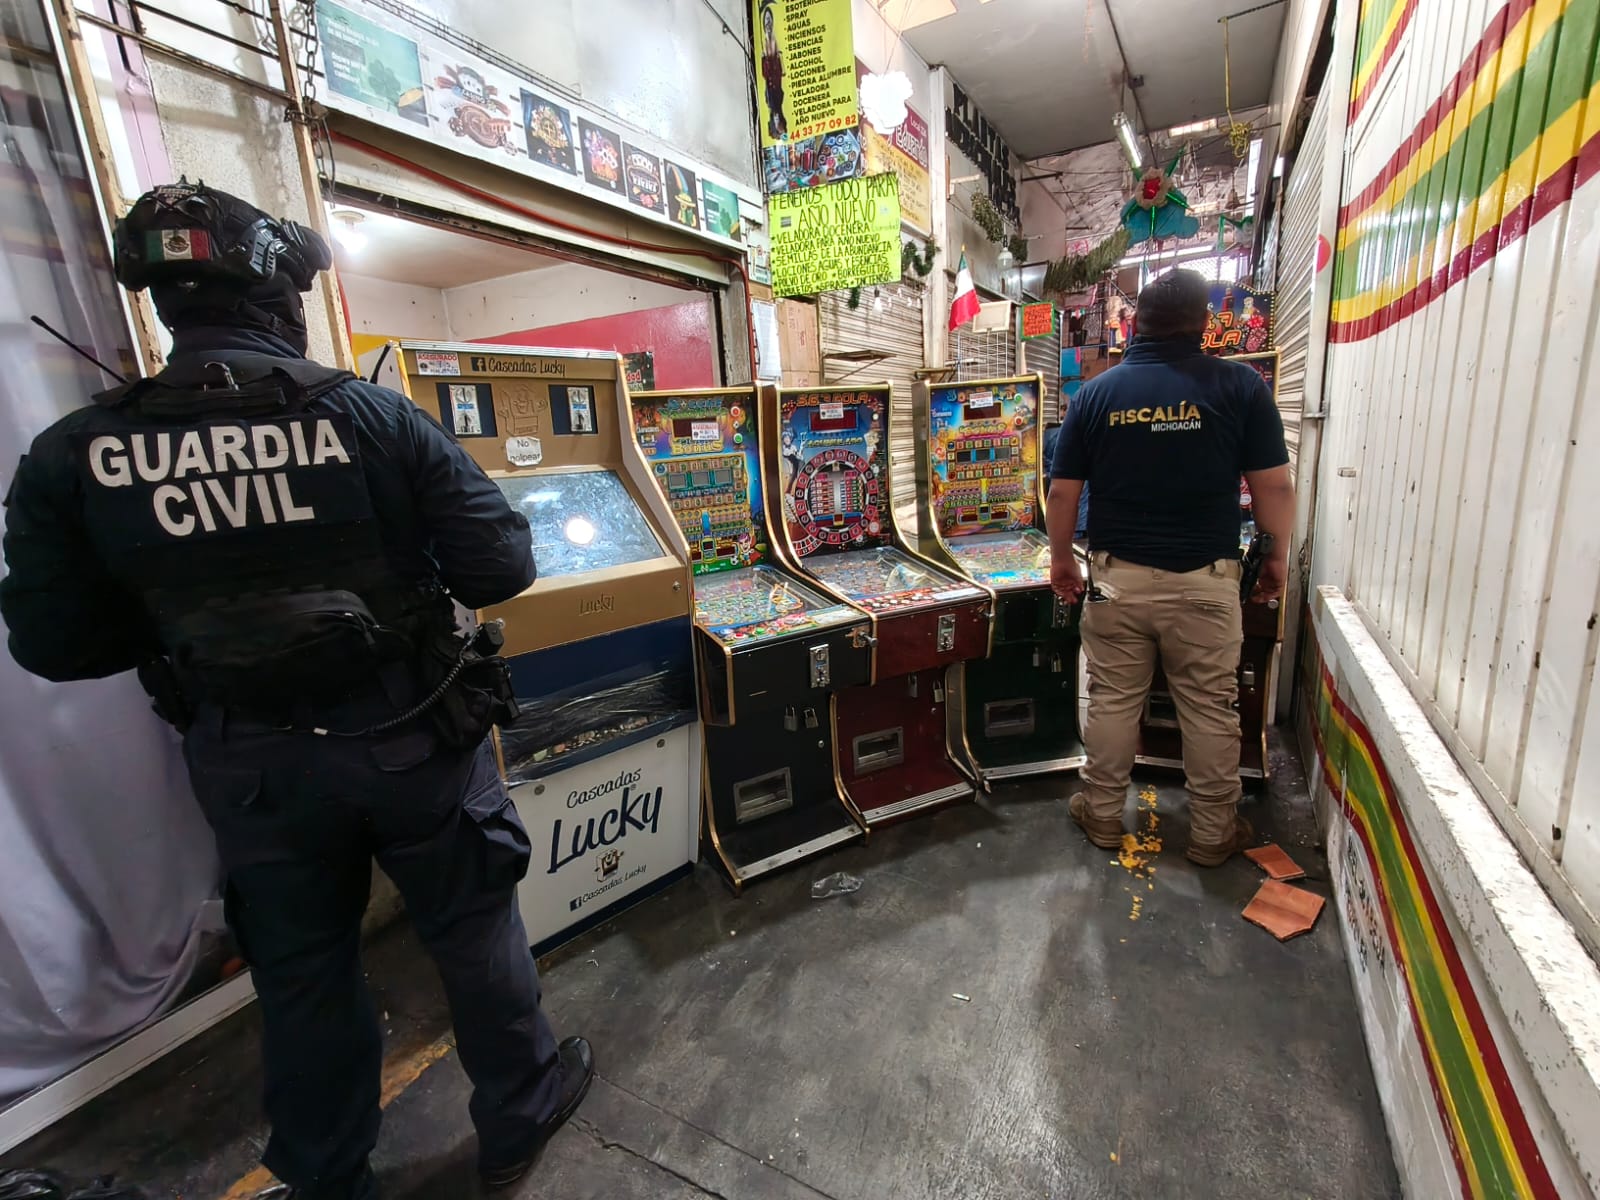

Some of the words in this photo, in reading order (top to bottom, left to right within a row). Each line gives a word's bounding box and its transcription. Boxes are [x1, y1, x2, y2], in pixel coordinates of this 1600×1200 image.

[786, 9, 808, 22] SPRAY
[786, 19, 811, 32] AGUAS
[787, 25, 826, 42] INCIENSOS
[788, 36, 823, 51] ESENCIAS
[789, 47, 822, 61] JABONES
[789, 56, 823, 71] ALCOHOL
[790, 65, 826, 80] LOCIONES
[791, 76, 817, 89] PIEDRA
[819, 66, 852, 82] ALUMBRE
[792, 83, 830, 98] VELADORA
[793, 92, 831, 108] DOCENERA
[793, 101, 831, 117] VELADORA
[832, 95, 852, 106] PARA
[795, 115, 809, 126] AÑO
[811, 109, 836, 122] NUEVO
[790, 130, 801, 141] 44
[802, 125, 813, 137] 33
[815, 122, 826, 133] 77
[829, 118, 842, 129] 09
[845, 114, 857, 126] 82
[773, 186, 823, 211] TENEMOS
[826, 178, 861, 202] TODO
[799, 204, 829, 230] AÑO
[834, 199, 876, 225] NUEVO
[775, 227, 821, 244] VELADORA
[775, 239, 816, 255] VELADORA
[776, 249, 819, 267] SEMILLAS
[820, 247, 831, 259] DE
[833, 246, 844, 258] LA
[776, 261, 817, 278] LOCIONES
[851, 252, 888, 268] ESENCIAS
[778, 276, 799, 289] POLVO
[800, 273, 811, 285] DE
[811, 271, 828, 284] ORO
[488, 356, 537, 373] Cascadas
[540, 359, 566, 377] Lucky
[1109, 400, 1201, 426] FISCALÍA
[1151, 419, 1201, 433] MICHOACÁN
[88, 418, 351, 488] GUARDIA
[517, 440, 529, 448] No
[152, 472, 314, 537] CIVIL
[566, 768, 642, 808] Cascadas
[546, 786, 663, 874] Lucky
[582, 877, 623, 903] Cascadas
[624, 863, 647, 882] Lucky
